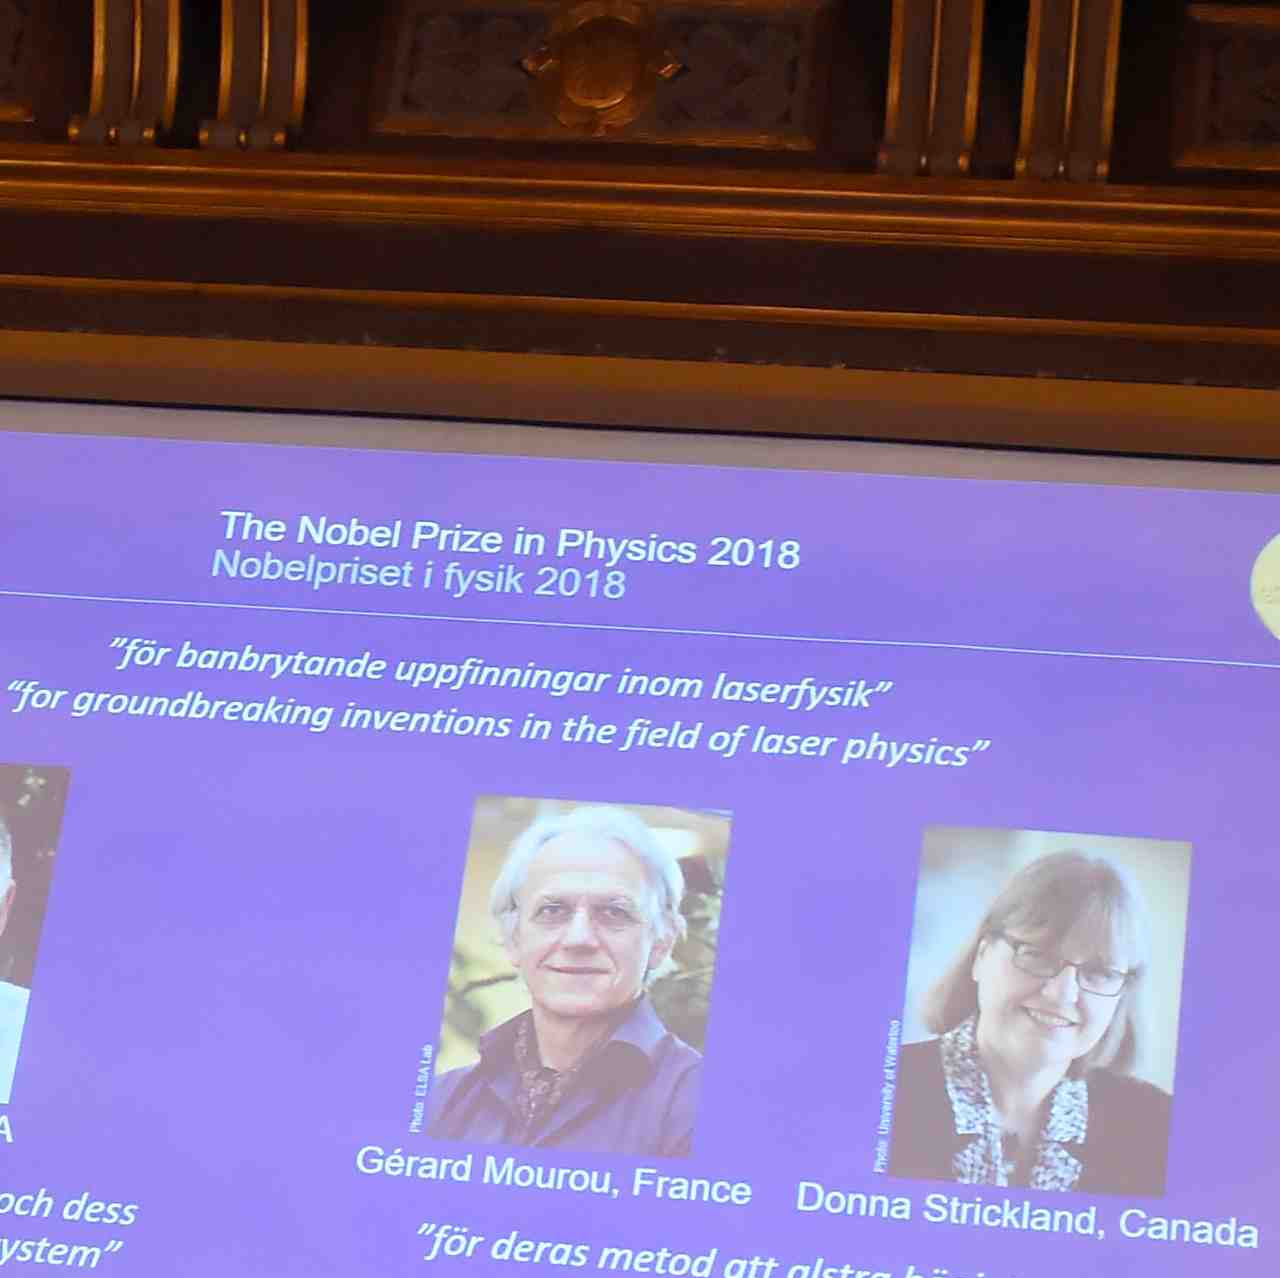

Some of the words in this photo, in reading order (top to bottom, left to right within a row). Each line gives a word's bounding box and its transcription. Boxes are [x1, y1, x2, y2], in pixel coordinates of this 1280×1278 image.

[220, 510, 287, 542] The
[296, 515, 402, 548] Nobel
[411, 521, 504, 553] Prize
[513, 526, 545, 556] in
[556, 528, 697, 568] Physics
[707, 536, 801, 569] 2018
[212, 548, 415, 590] Nobelpriset
[423, 560, 433, 589] i
[443, 561, 525, 598] fysik
[533, 566, 626, 599] 2018
[108, 637, 173, 670] ”för
[175, 640, 387, 680] banbrytande
[394, 657, 612, 697] uppfinningar
[617, 667, 704, 699] inom
[711, 672, 894, 711] laserfysik”
[7, 680, 69, 713] “for
[70, 690, 335, 732] groundbreaking
[340, 701, 513, 738] inventions
[519, 712, 552, 740] in
[561, 714, 618, 744] the
[618, 718, 703, 751] field
[708, 724, 751, 758] of
[751, 725, 839, 757] laser
[840, 731, 991, 768] physics”
[356, 1145, 473, 1182] Gérard
[482, 1155, 620, 1199] Mourou,
[632, 1167, 752, 1205] France
[62, 1191, 139, 1225] dess
[797, 1181, 911, 1220] Donna
[923, 1193, 1105, 1241] Strickland,
[1119, 1208, 1259, 1249] Canada
[417, 1222, 485, 1261] ”för
[490, 1230, 590, 1267] deras
[597, 1247, 718, 1278] metod
